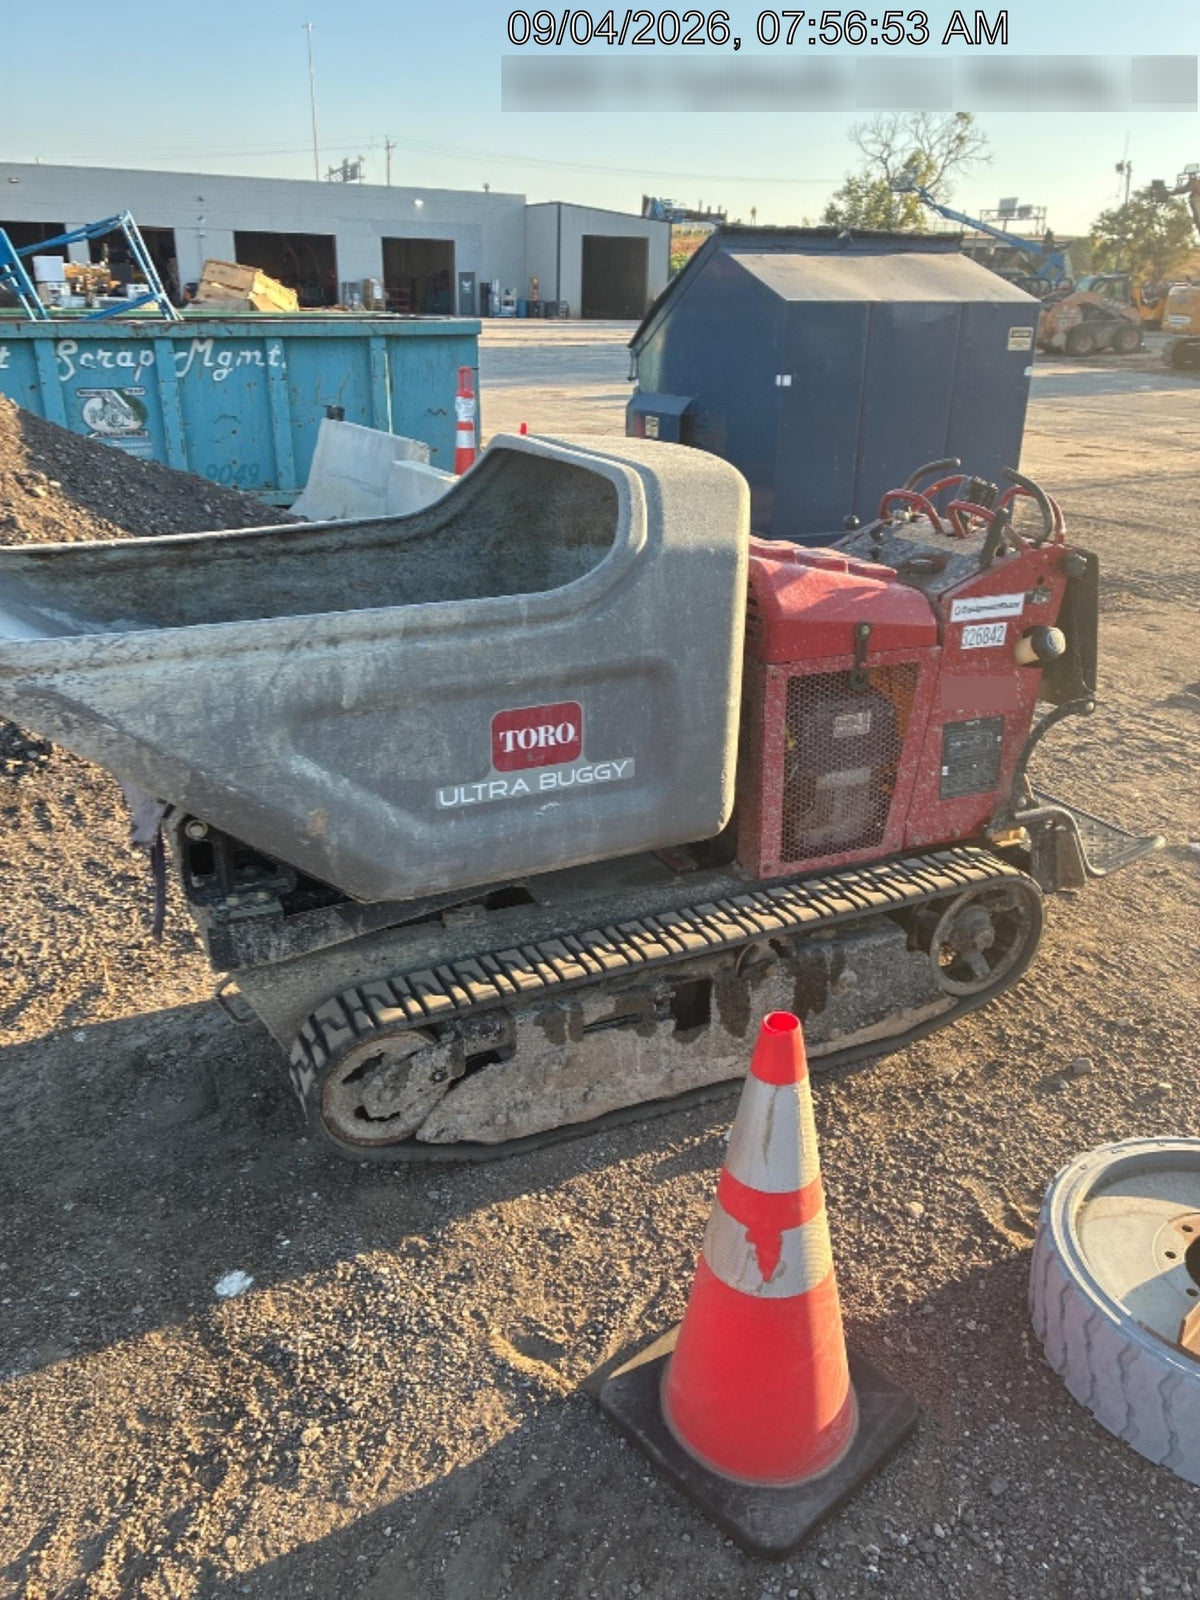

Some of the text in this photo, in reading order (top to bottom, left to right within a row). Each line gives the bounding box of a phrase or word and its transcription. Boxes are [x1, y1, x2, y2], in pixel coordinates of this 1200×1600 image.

[56, 339, 155, 382] Scrap
[173, 338, 287, 382] Mgmt.
[205, 463, 261, 485] 9049
[499, 721, 576, 753] TORO
[438, 760, 628, 806] ULTRA BUGGY
